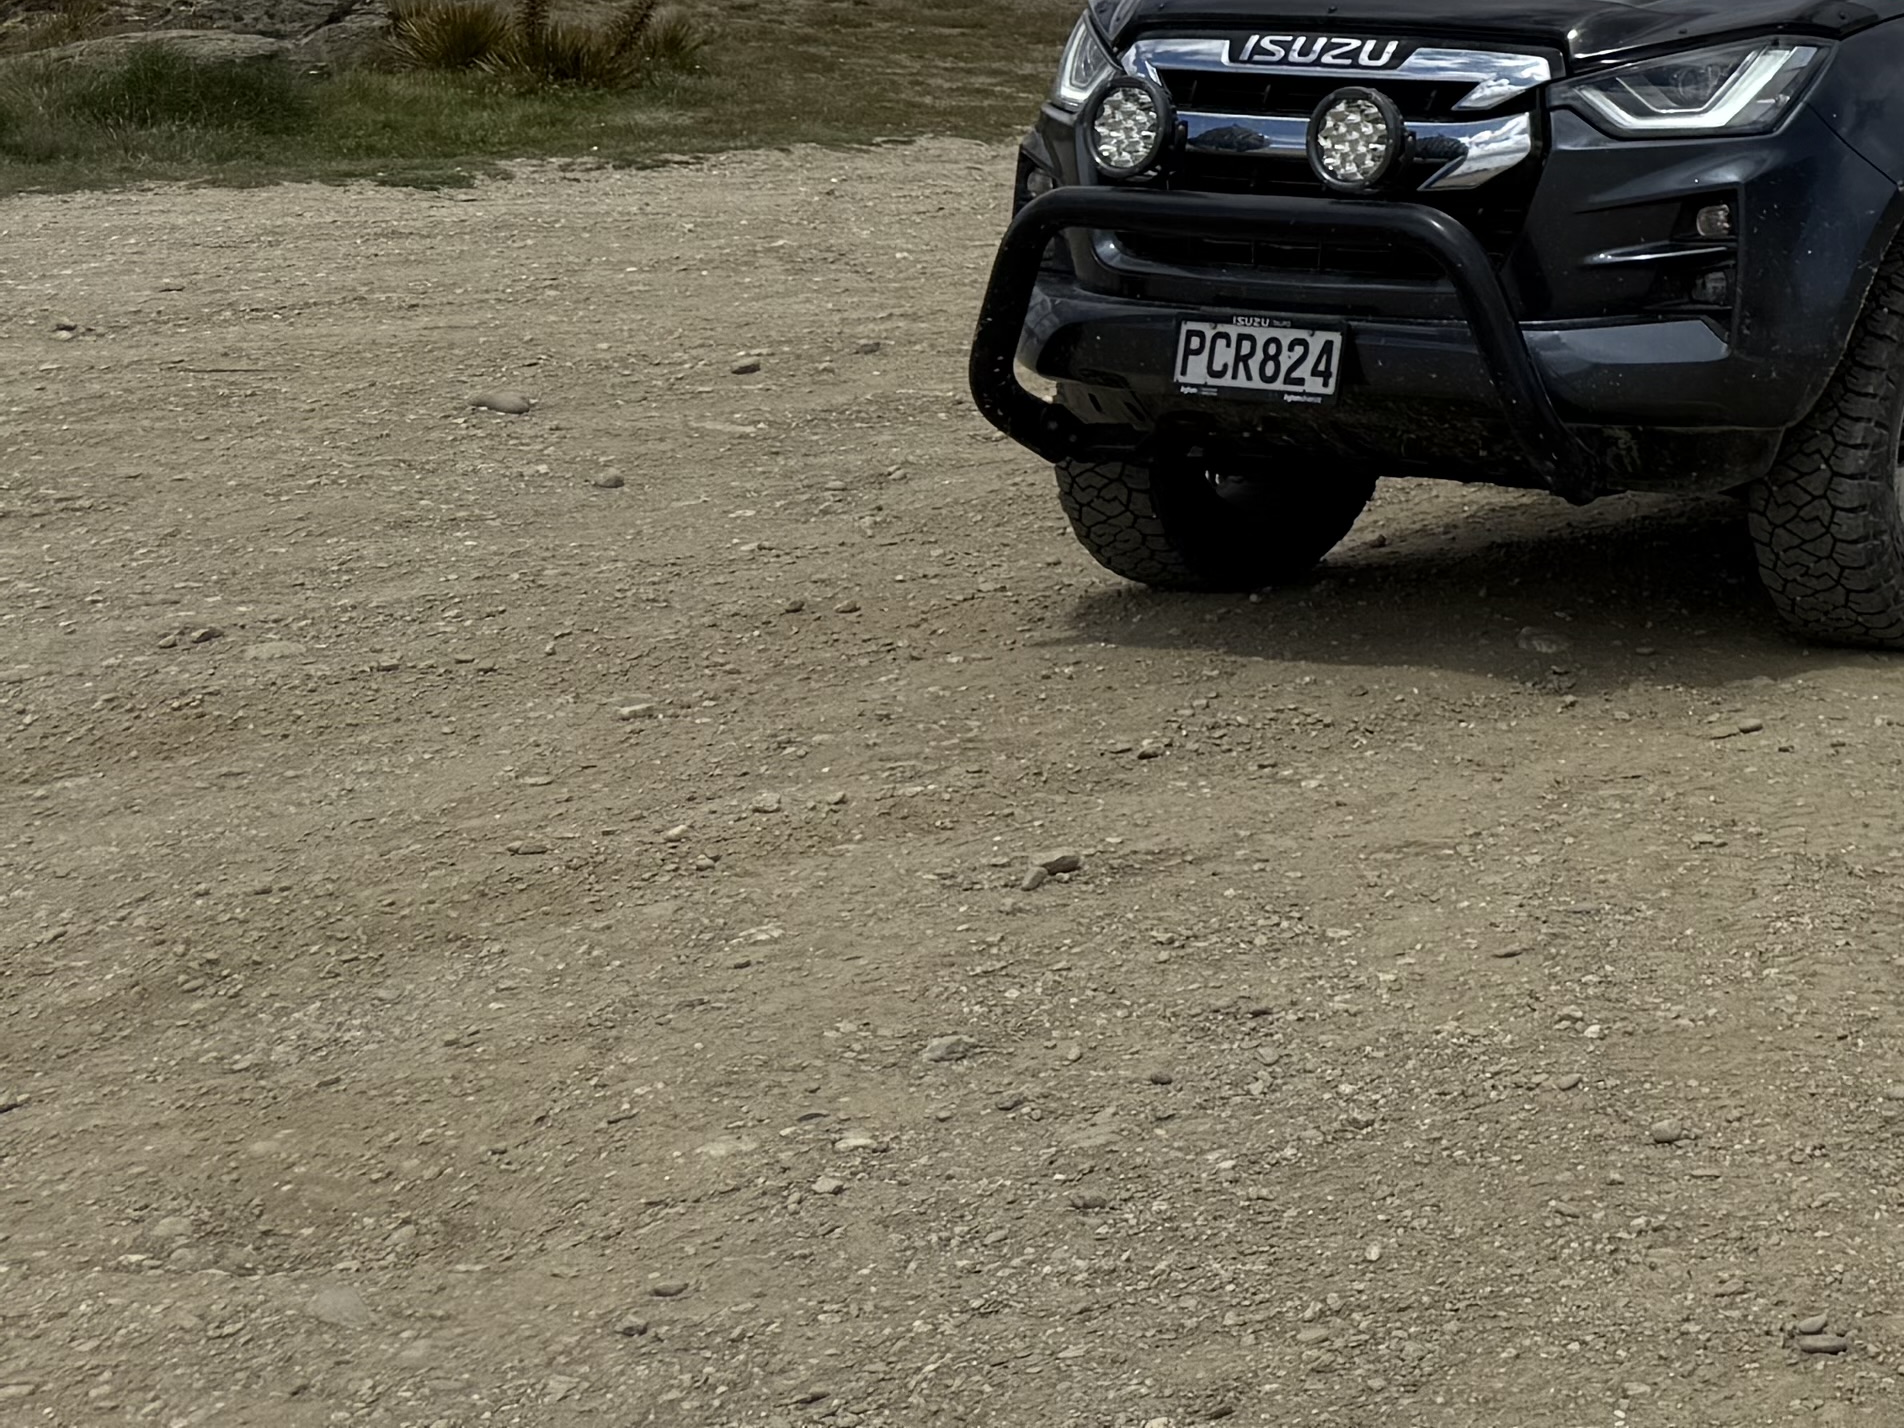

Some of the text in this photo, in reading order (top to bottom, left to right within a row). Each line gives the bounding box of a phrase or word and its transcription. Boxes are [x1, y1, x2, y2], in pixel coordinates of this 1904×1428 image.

[1239, 35, 1399, 67] ISUZU
[1232, 316, 1270, 327] ISUZU
[1180, 329, 1335, 388] PCR824
